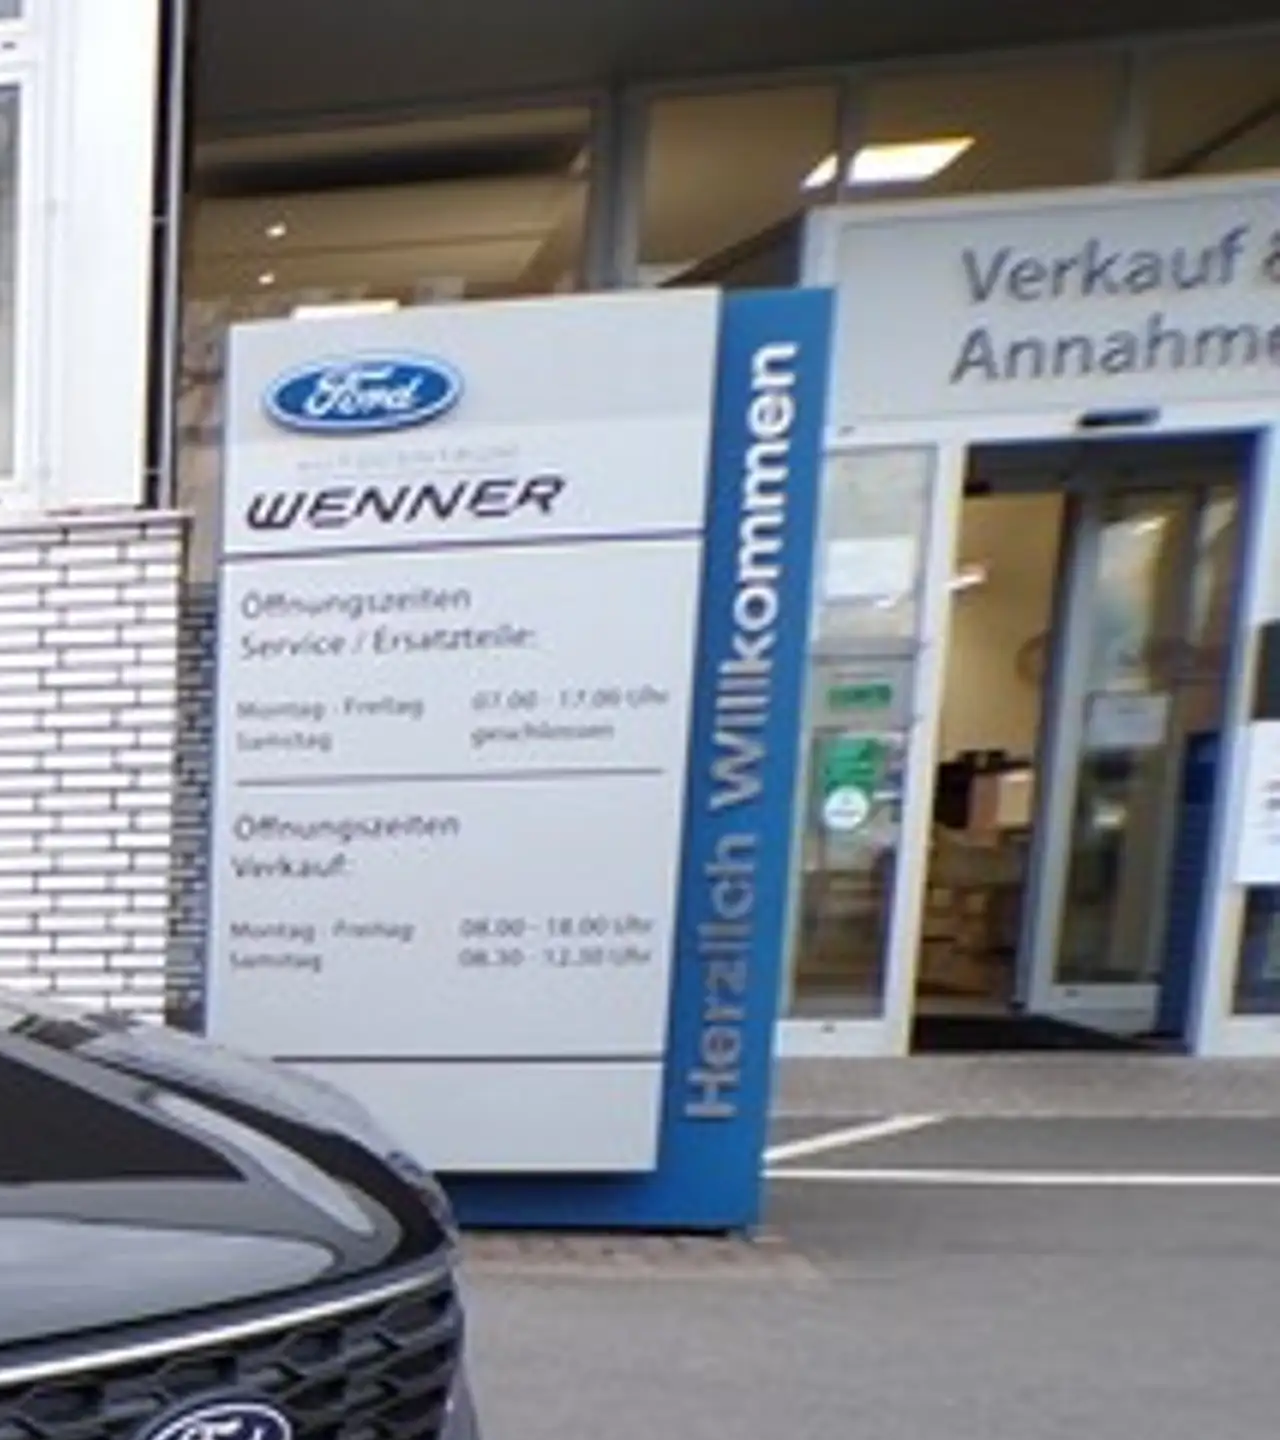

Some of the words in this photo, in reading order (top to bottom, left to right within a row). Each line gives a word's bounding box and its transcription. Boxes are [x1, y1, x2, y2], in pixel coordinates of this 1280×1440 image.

[961, 223, 1251, 303] Verkauf
[246, 472, 566, 530] WENNER
[707, 340, 799, 812] Willkommen
[241, 629, 345, 660] Service
[684, 832, 758, 1119] Herzlich
